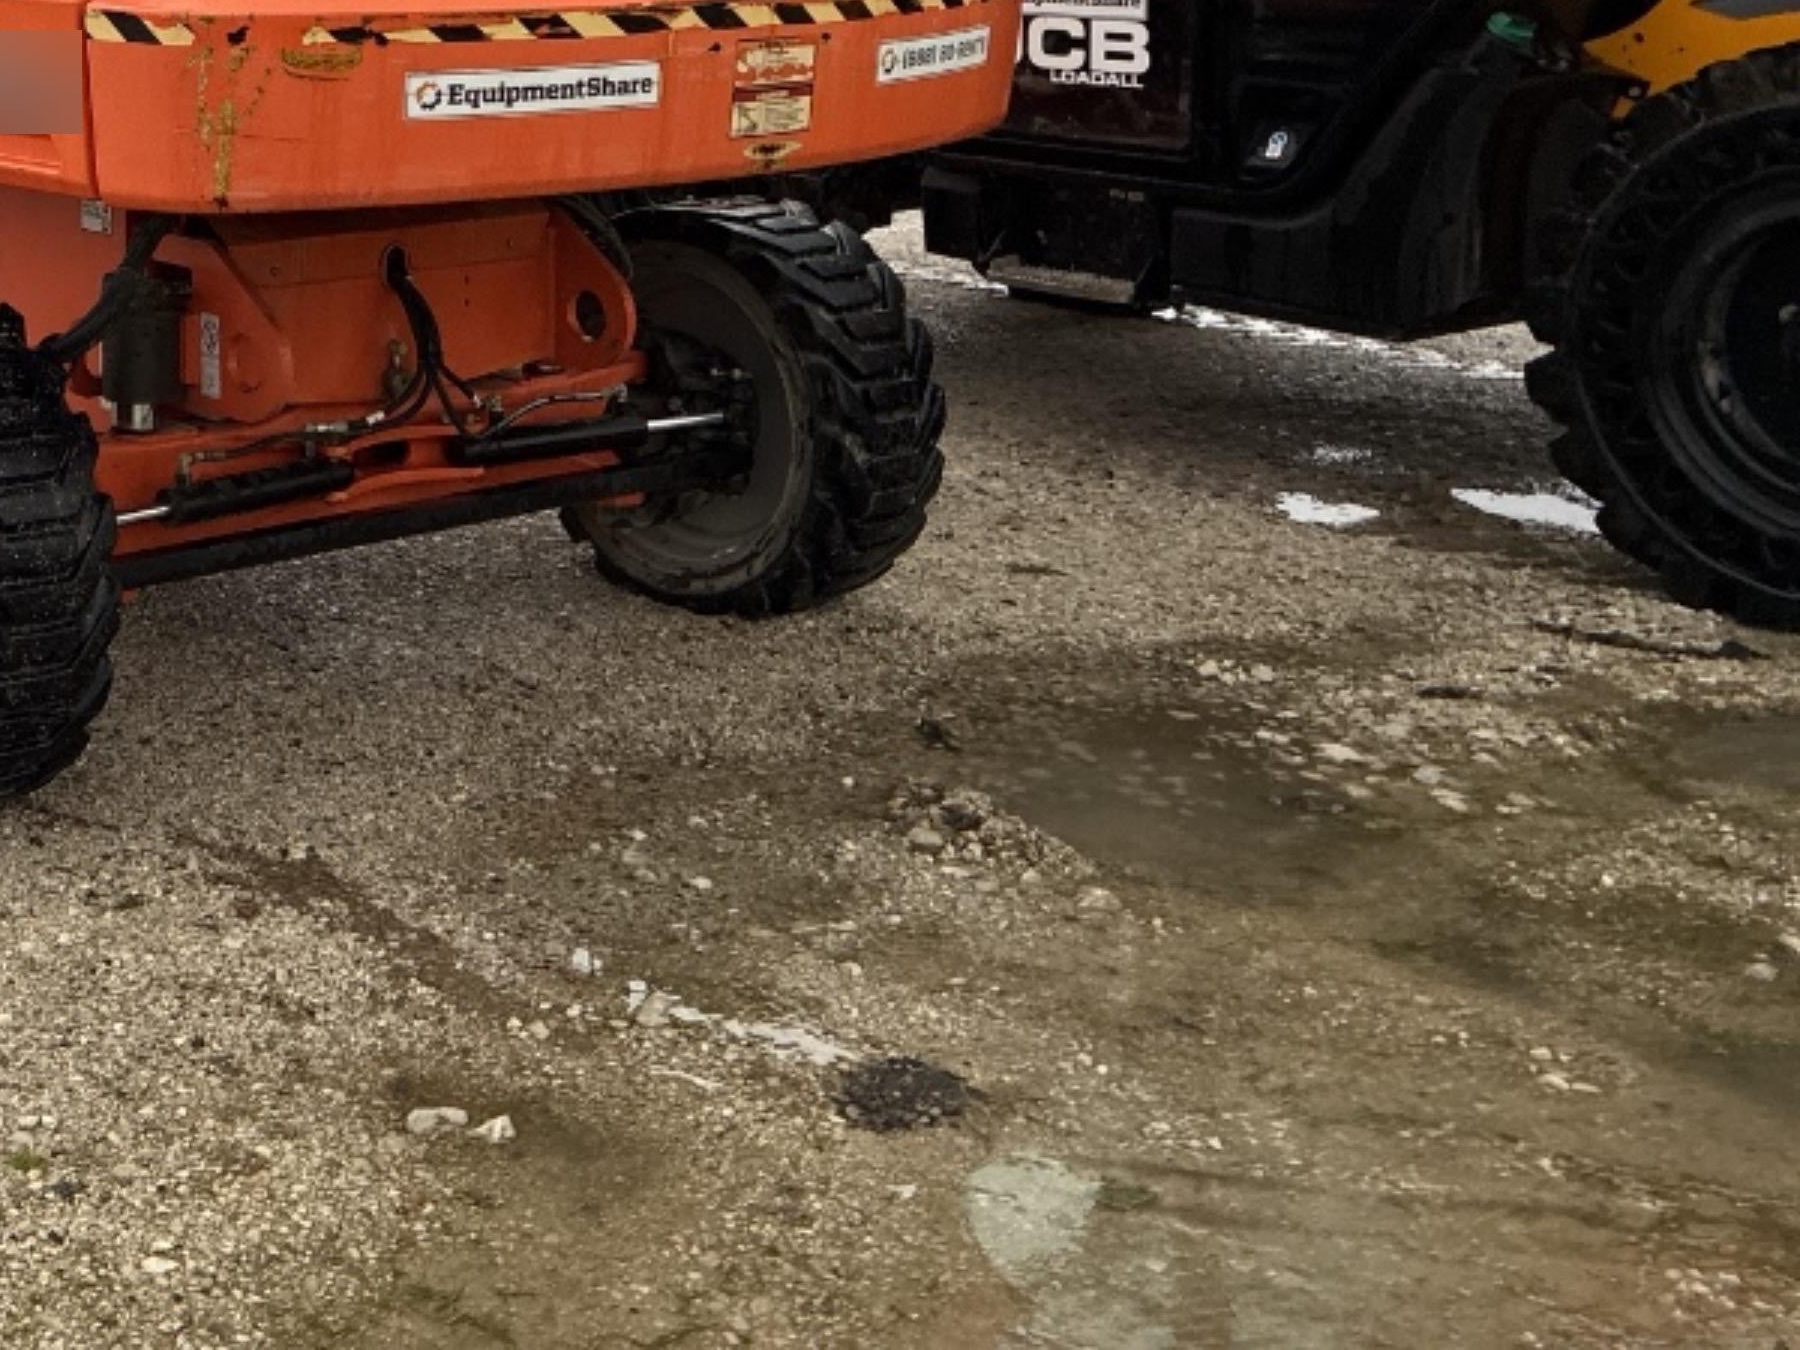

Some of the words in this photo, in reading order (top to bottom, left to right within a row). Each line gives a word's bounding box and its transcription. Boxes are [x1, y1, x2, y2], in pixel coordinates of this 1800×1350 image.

[1015, 16, 1150, 73] CB
[446, 76, 653, 108] EquipmentShare
[1050, 70, 1145, 89] LOADALL
